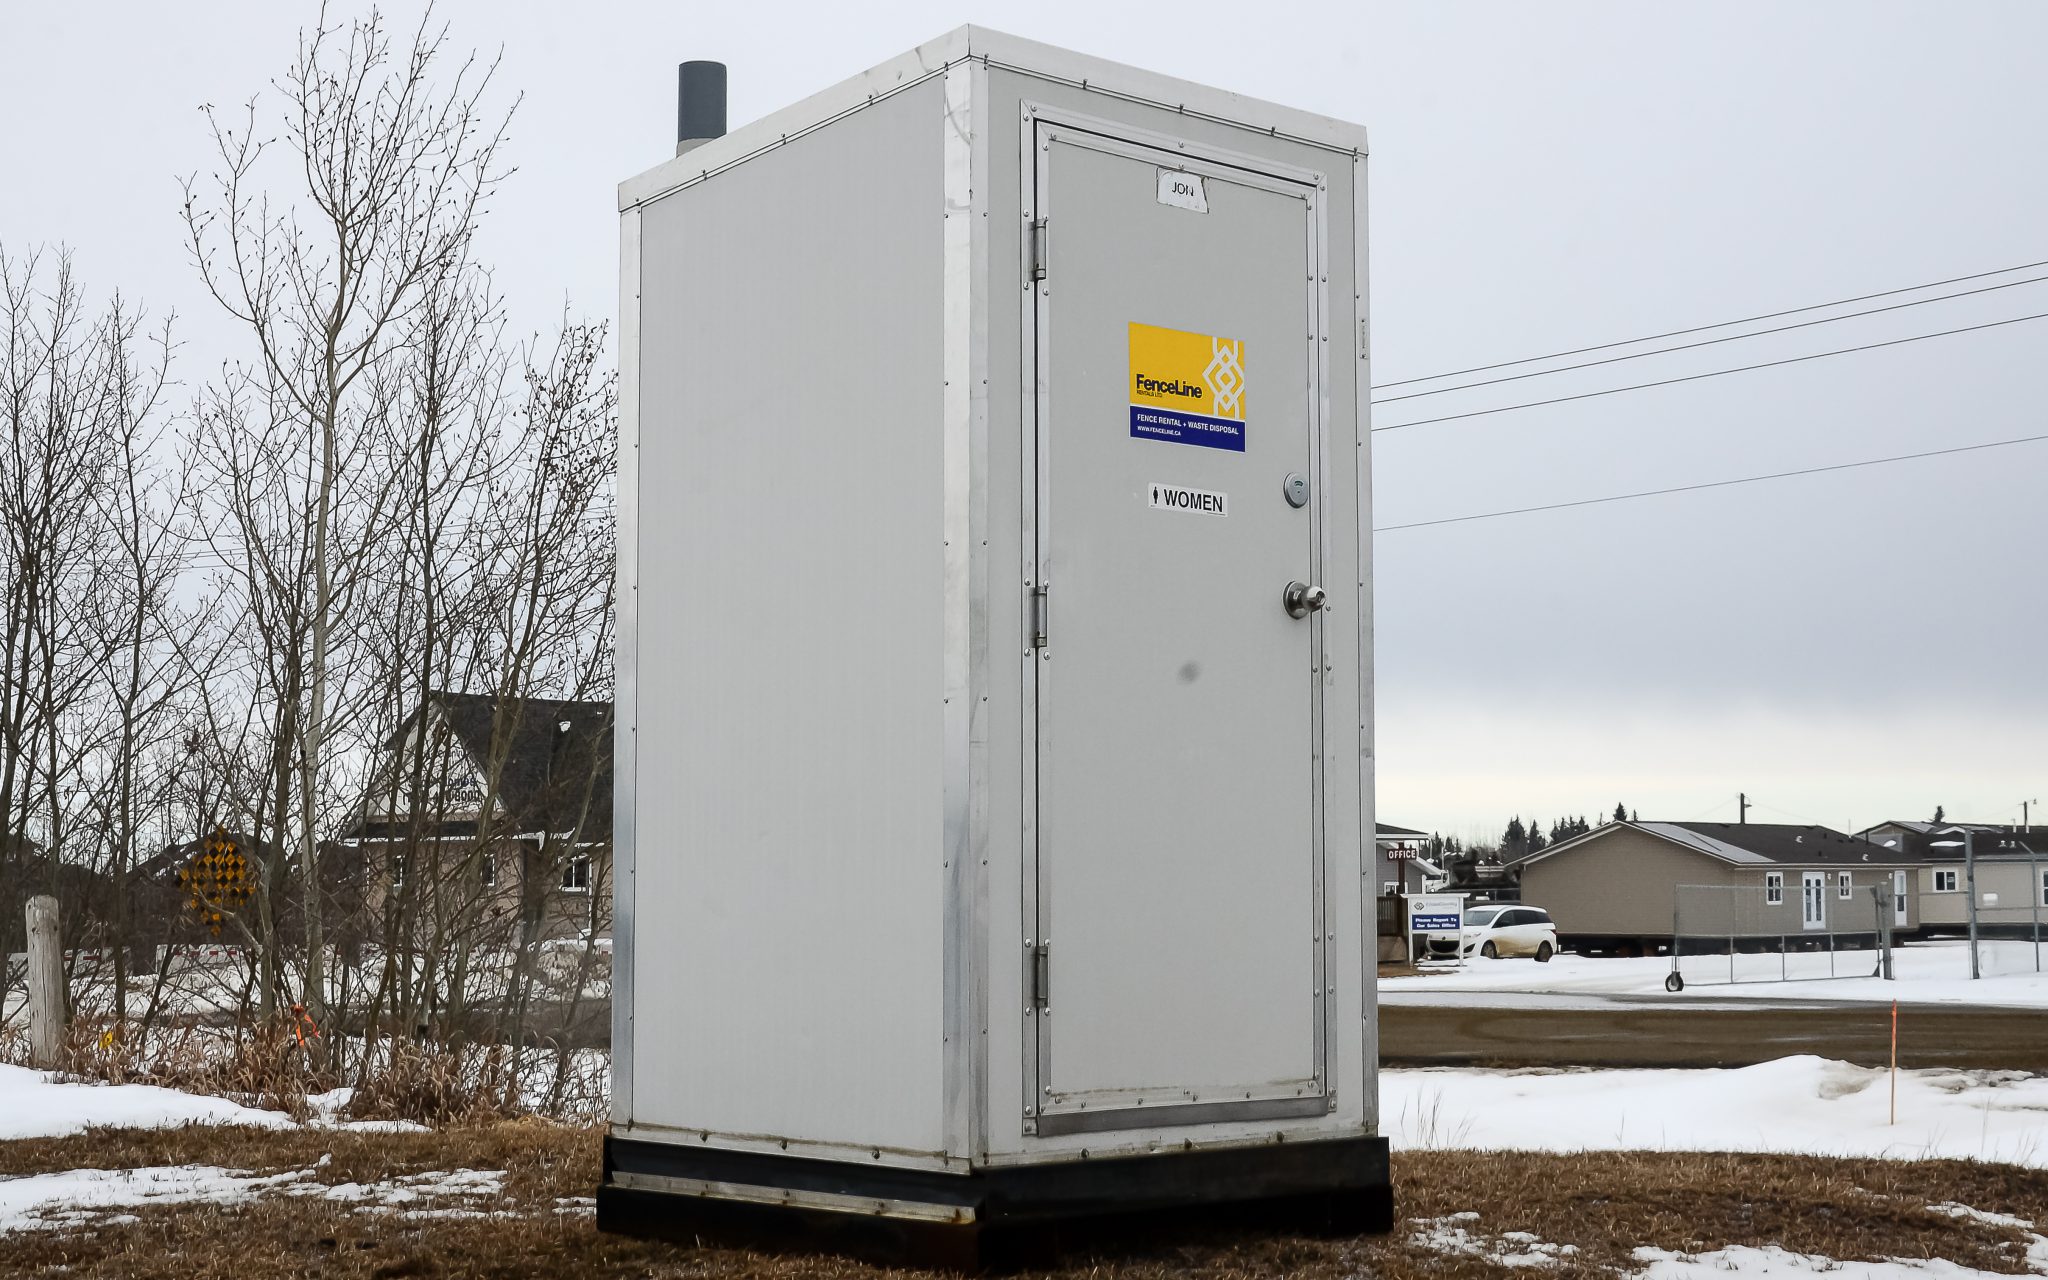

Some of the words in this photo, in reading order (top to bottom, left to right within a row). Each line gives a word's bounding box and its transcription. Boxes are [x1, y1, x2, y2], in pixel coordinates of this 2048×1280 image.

[1136, 374, 1202, 398] FenceLine
[1137, 414, 1157, 424] FENCE
[1158, 416, 1181, 427] RENTAL
[1188, 421, 1208, 431] WASTE
[1210, 424, 1239, 434] DISPOSAL
[1164, 488, 1222, 512] WOMEN
[1388, 850, 1416, 859] OFFICE
